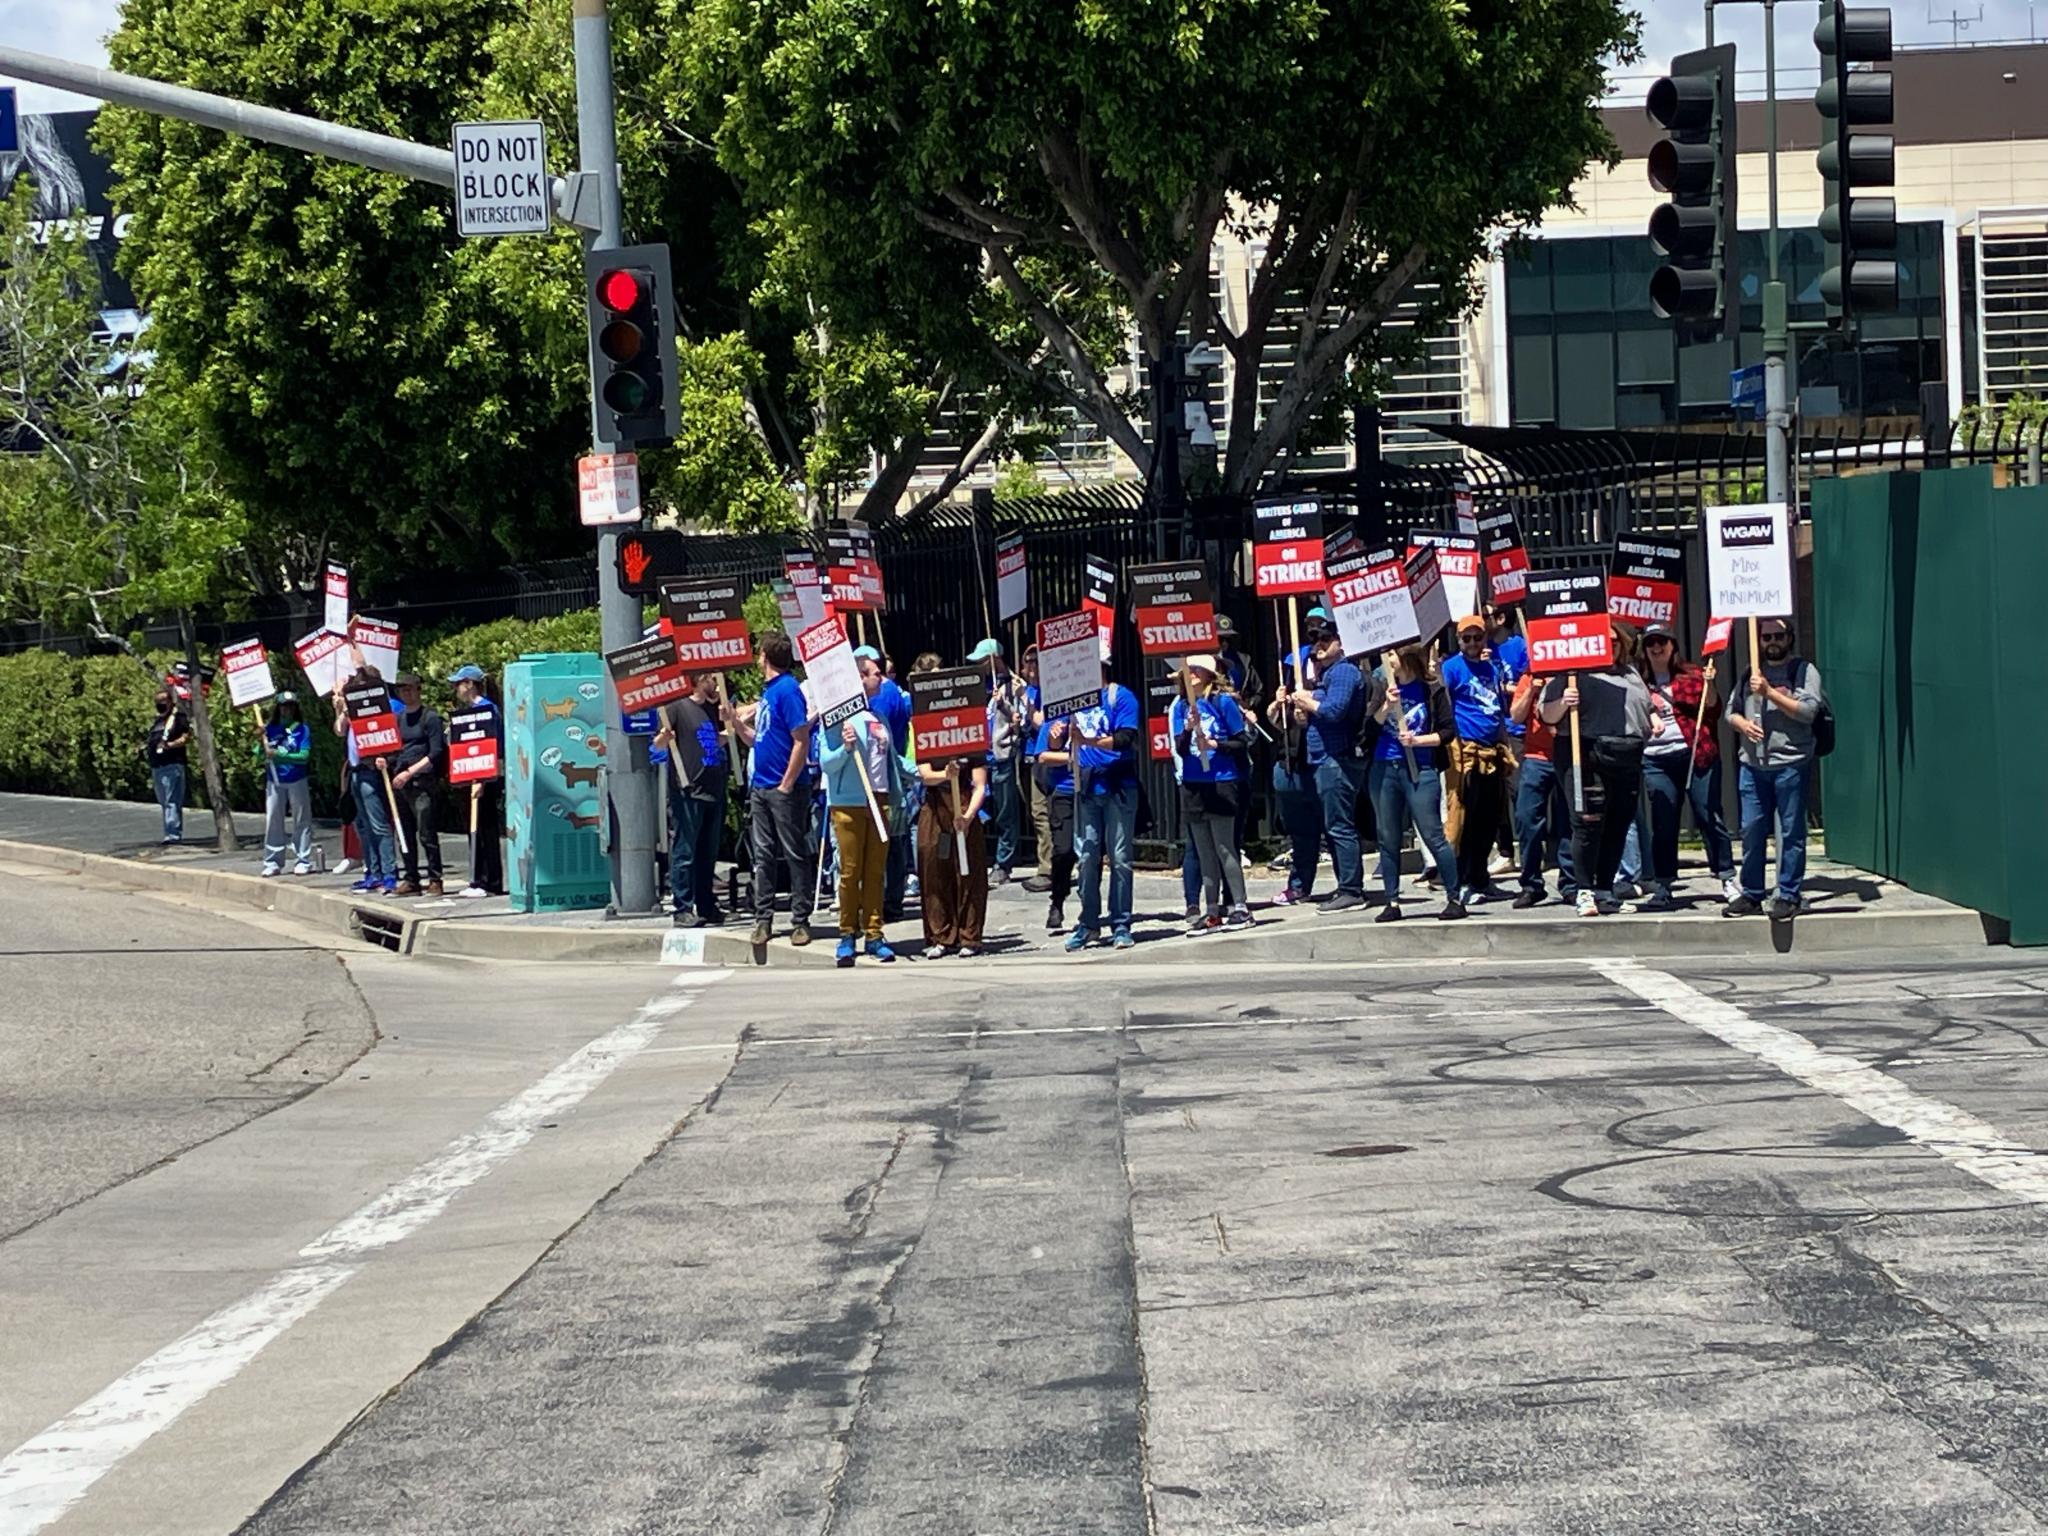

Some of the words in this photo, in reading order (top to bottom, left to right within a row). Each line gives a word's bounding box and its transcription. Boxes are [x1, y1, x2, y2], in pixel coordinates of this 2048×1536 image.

[461, 138, 490, 163] DO
[497, 137, 538, 162] NOT
[463, 173, 541, 199] BLOCK
[464, 205, 543, 224] INTERSECTION
[1722, 524, 1771, 539] WGAW
[1281, 548, 1298, 561] ON
[1258, 560, 1322, 586] STRIKE!
[1332, 566, 1402, 604] STRIKE!
[1529, 579, 1571, 593] WRITERS
[1572, 576, 1600, 589] GUILD
[1636, 585, 1652, 598] ON
[1560, 592, 1571, 601] OF
[1167, 612, 1183, 623] ON
[1545, 601, 1588, 615] AMERICA
[1608, 595, 1673, 621] STRIKE!
[1143, 622, 1213, 645] STRIKE!
[1560, 623, 1577, 636] ON
[680, 638, 746, 661] STRIKE!
[1532, 634, 1607, 662] STRIKE!
[622, 675, 687, 706] STRIKE!
[913, 678, 953, 692] WRITERS
[954, 675, 980, 687] GUILD
[943, 690, 953, 698] OF
[824, 696, 865, 727] STRIKE
[929, 697, 968, 711] AMERICA
[1047, 692, 1099, 719] STRIKE
[942, 716, 958, 728] ON
[917, 724, 985, 750] STRIKE!
